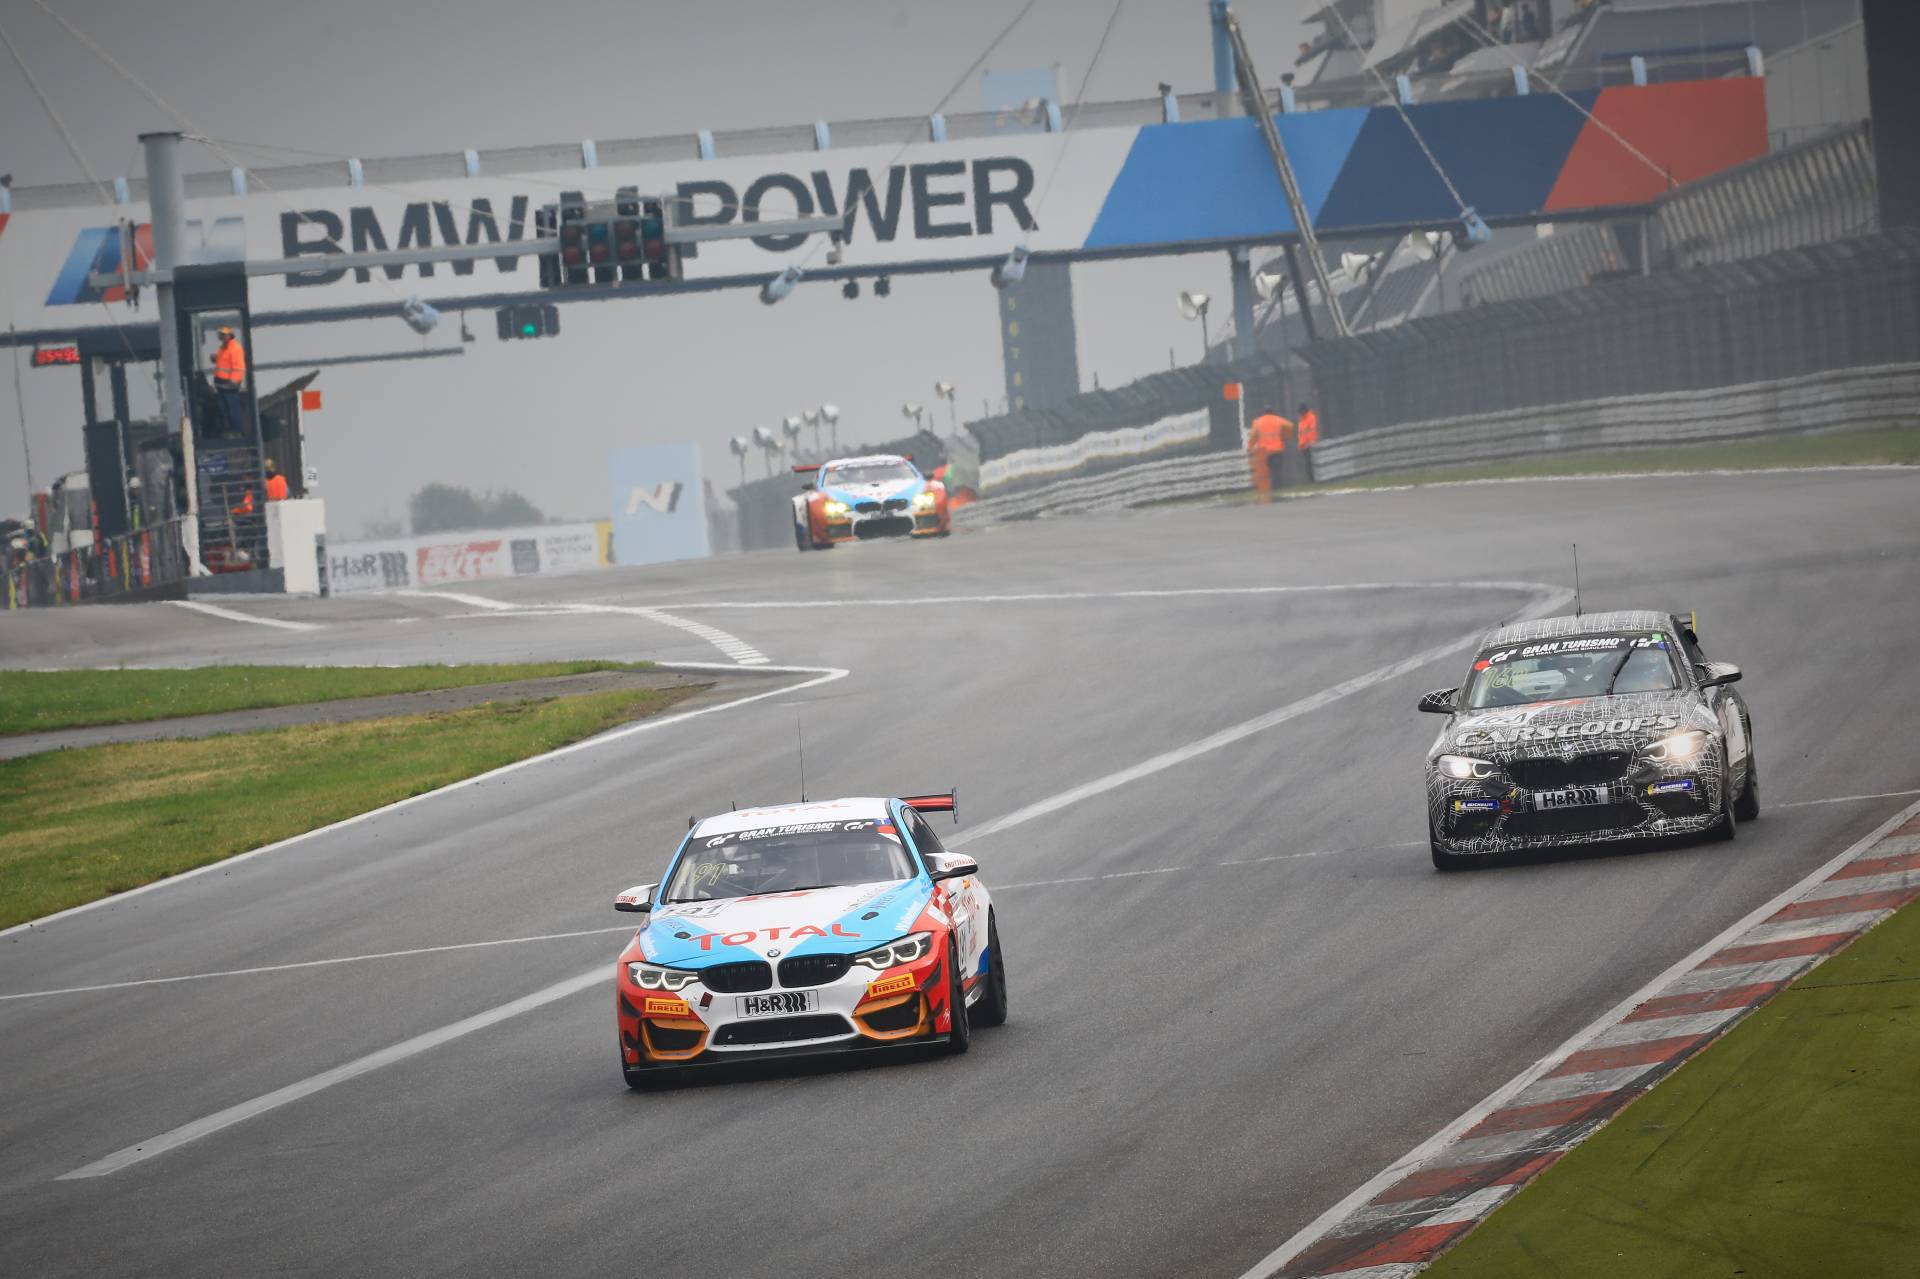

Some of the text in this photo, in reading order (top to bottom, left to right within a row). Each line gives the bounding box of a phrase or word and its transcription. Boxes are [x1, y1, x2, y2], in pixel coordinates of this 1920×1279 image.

[280, 193, 530, 290] BMW
[677, 156, 1040, 259] POWER
[1522, 637, 1620, 655] GRAN TURISMO
[1456, 714, 1679, 747] CARSCOOPS
[738, 821, 837, 840] GRAN TURISMO
[688, 922, 862, 951] TOTAL
[871, 976, 911, 994] PIRELLI
[648, 1000, 685, 1013] PIRELLI
